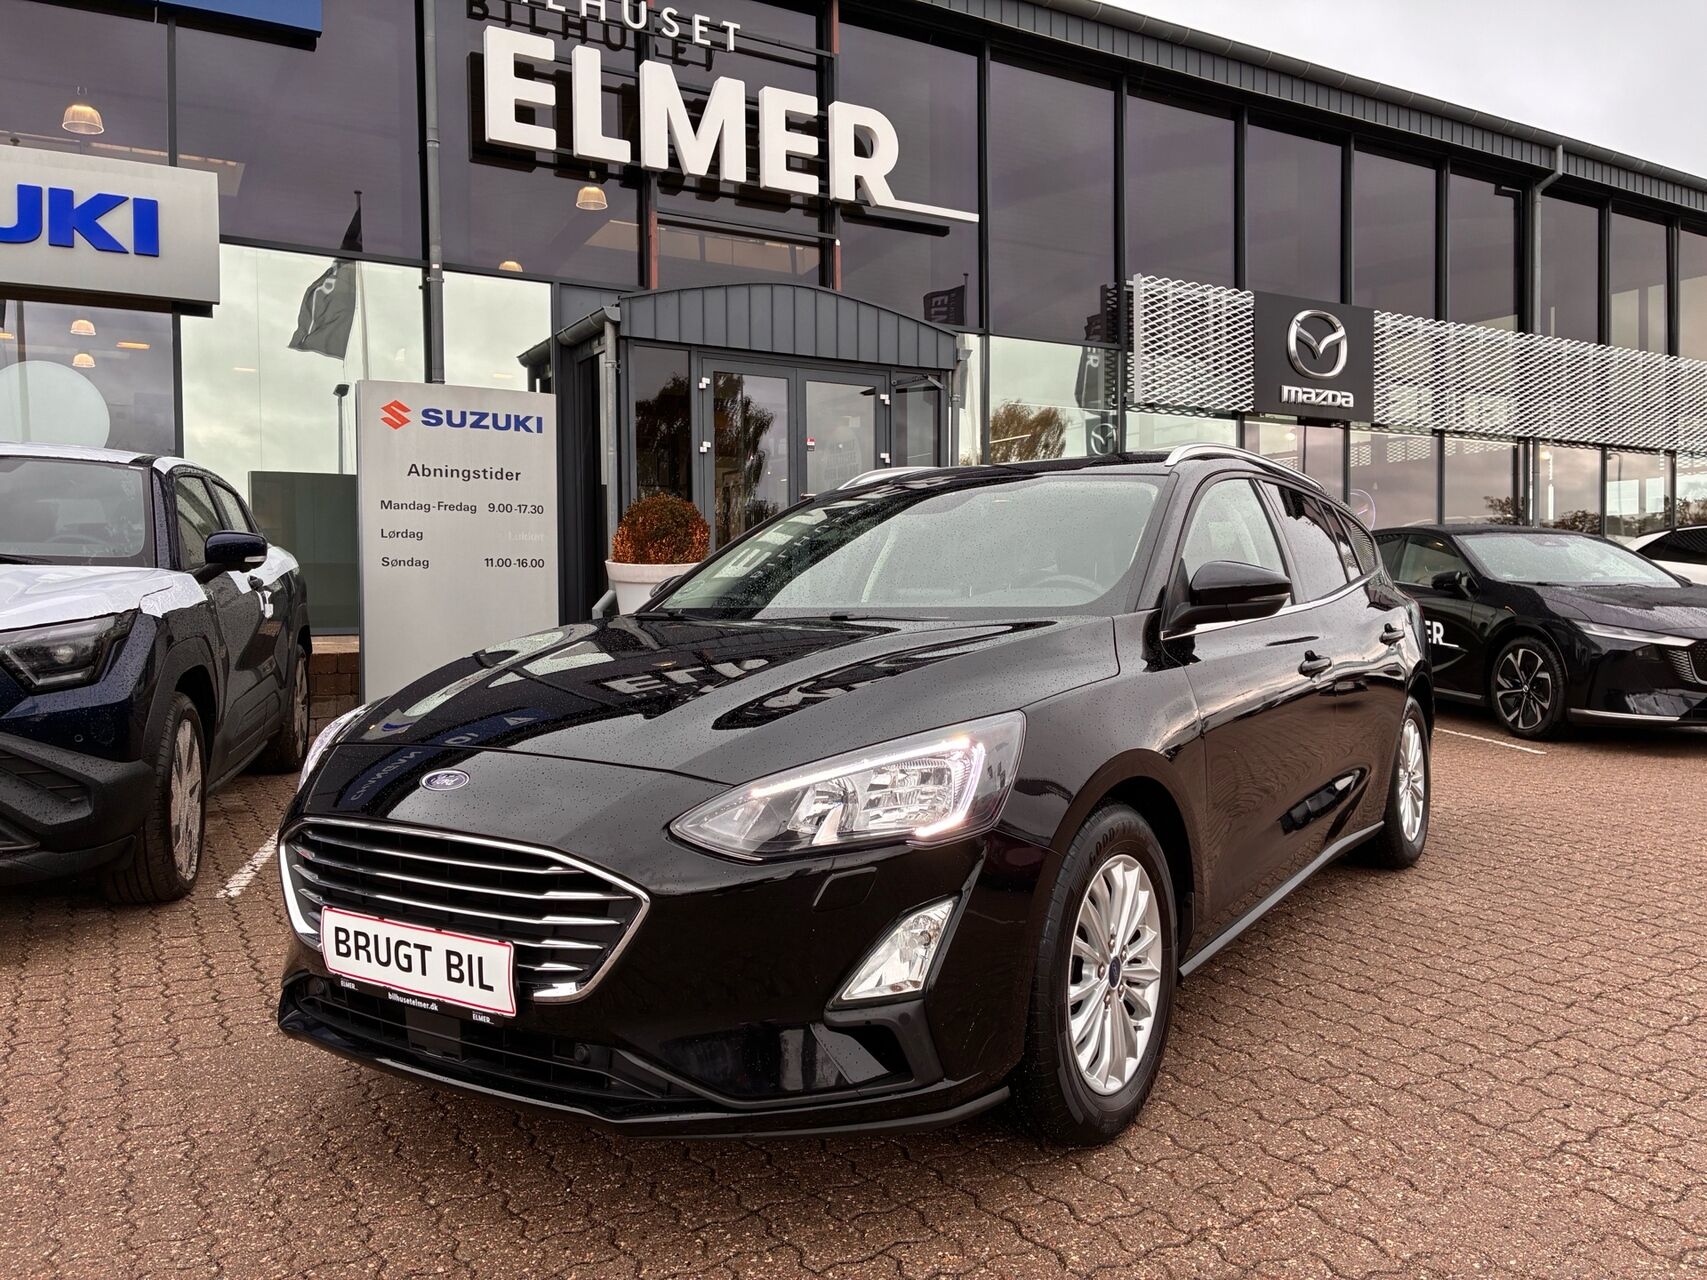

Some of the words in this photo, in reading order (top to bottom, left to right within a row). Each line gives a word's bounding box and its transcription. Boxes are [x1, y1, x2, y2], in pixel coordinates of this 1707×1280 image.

[521, 0, 740, 51] HUSET
[483, 25, 979, 223] ELMER
[421, 408, 543, 434] SUZUKI
[381, 528, 423, 541] Lørdag
[381, 556, 430, 569] Søndag
[333, 926, 432, 977] BRUGT
[445, 949, 495, 993] BIL
[472, 1013, 494, 1025] ELMER
